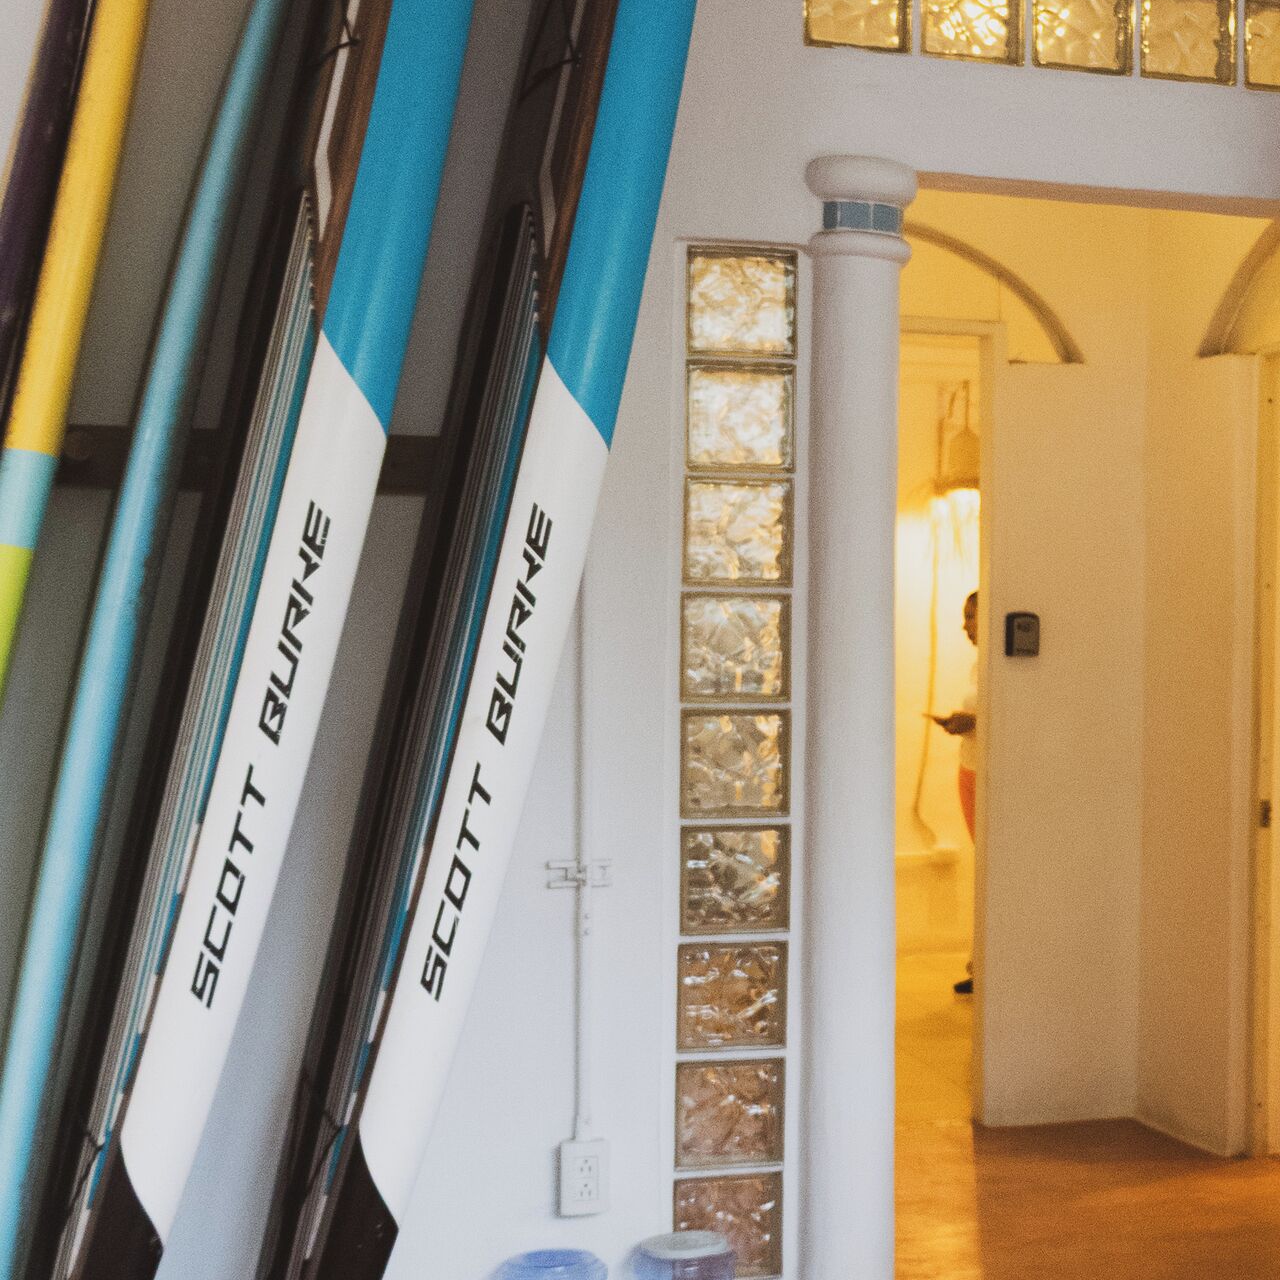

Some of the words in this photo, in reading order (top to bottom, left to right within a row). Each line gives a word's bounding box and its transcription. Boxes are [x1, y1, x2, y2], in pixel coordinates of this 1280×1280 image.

[190, 763, 266, 1009] SCOTT
[258, 499, 331, 746] BURKE
[420, 761, 492, 1003] SCOTT
[486, 502, 553, 746] BURKE
